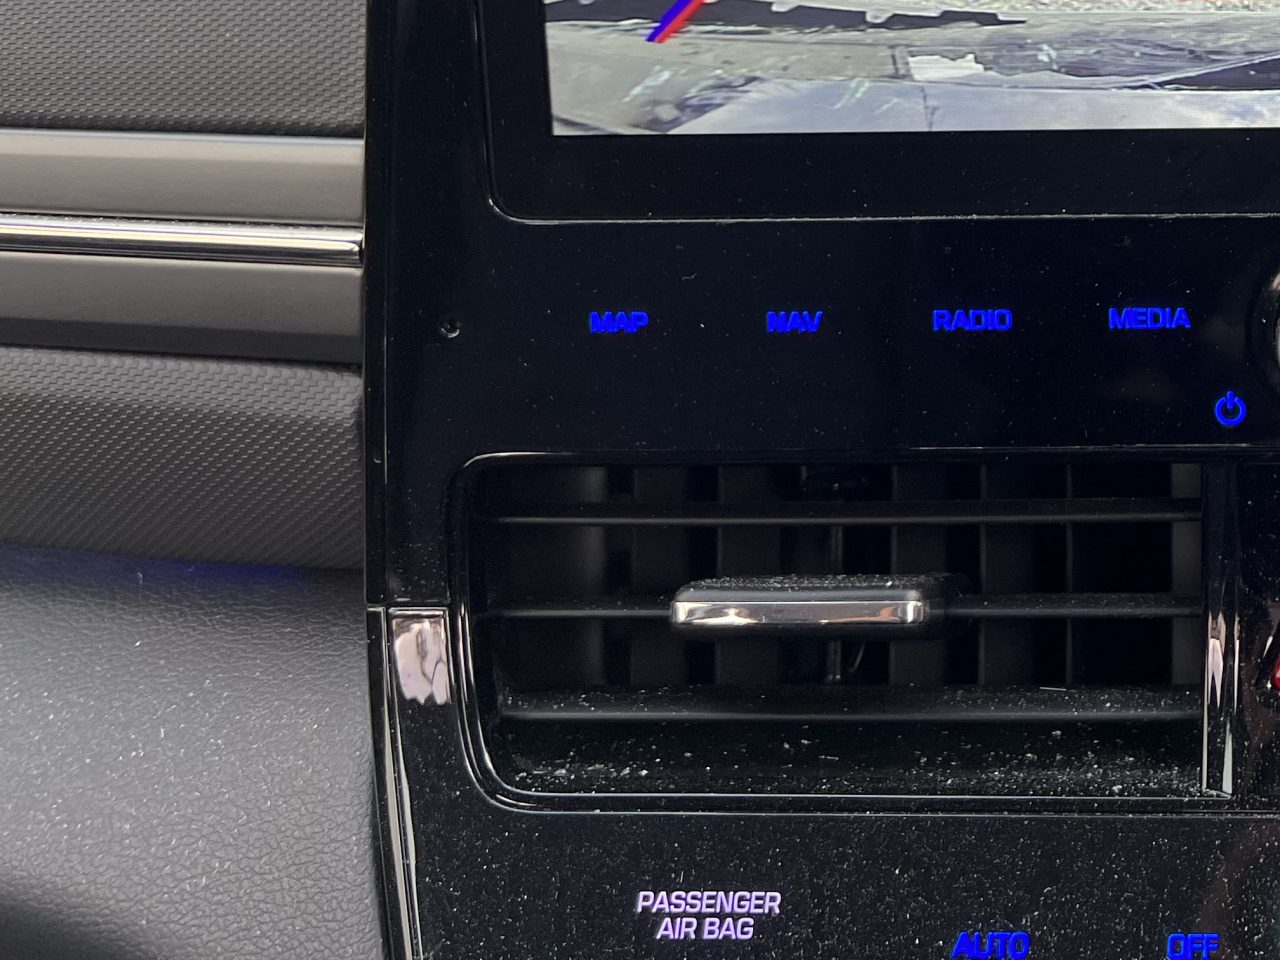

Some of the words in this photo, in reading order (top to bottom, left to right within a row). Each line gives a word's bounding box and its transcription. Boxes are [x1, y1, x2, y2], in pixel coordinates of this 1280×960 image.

[590, 311, 649, 333] MAP
[767, 311, 822, 333] NAV
[933, 309, 1012, 331] RADIO
[1109, 307, 1191, 330] MEDIA
[637, 891, 781, 913] PASSENGER
[656, 918, 697, 939] AIR
[703, 918, 754, 939] BAG
[952, 932, 1029, 960] AUTO
[1168, 933, 1219, 960] OFF
